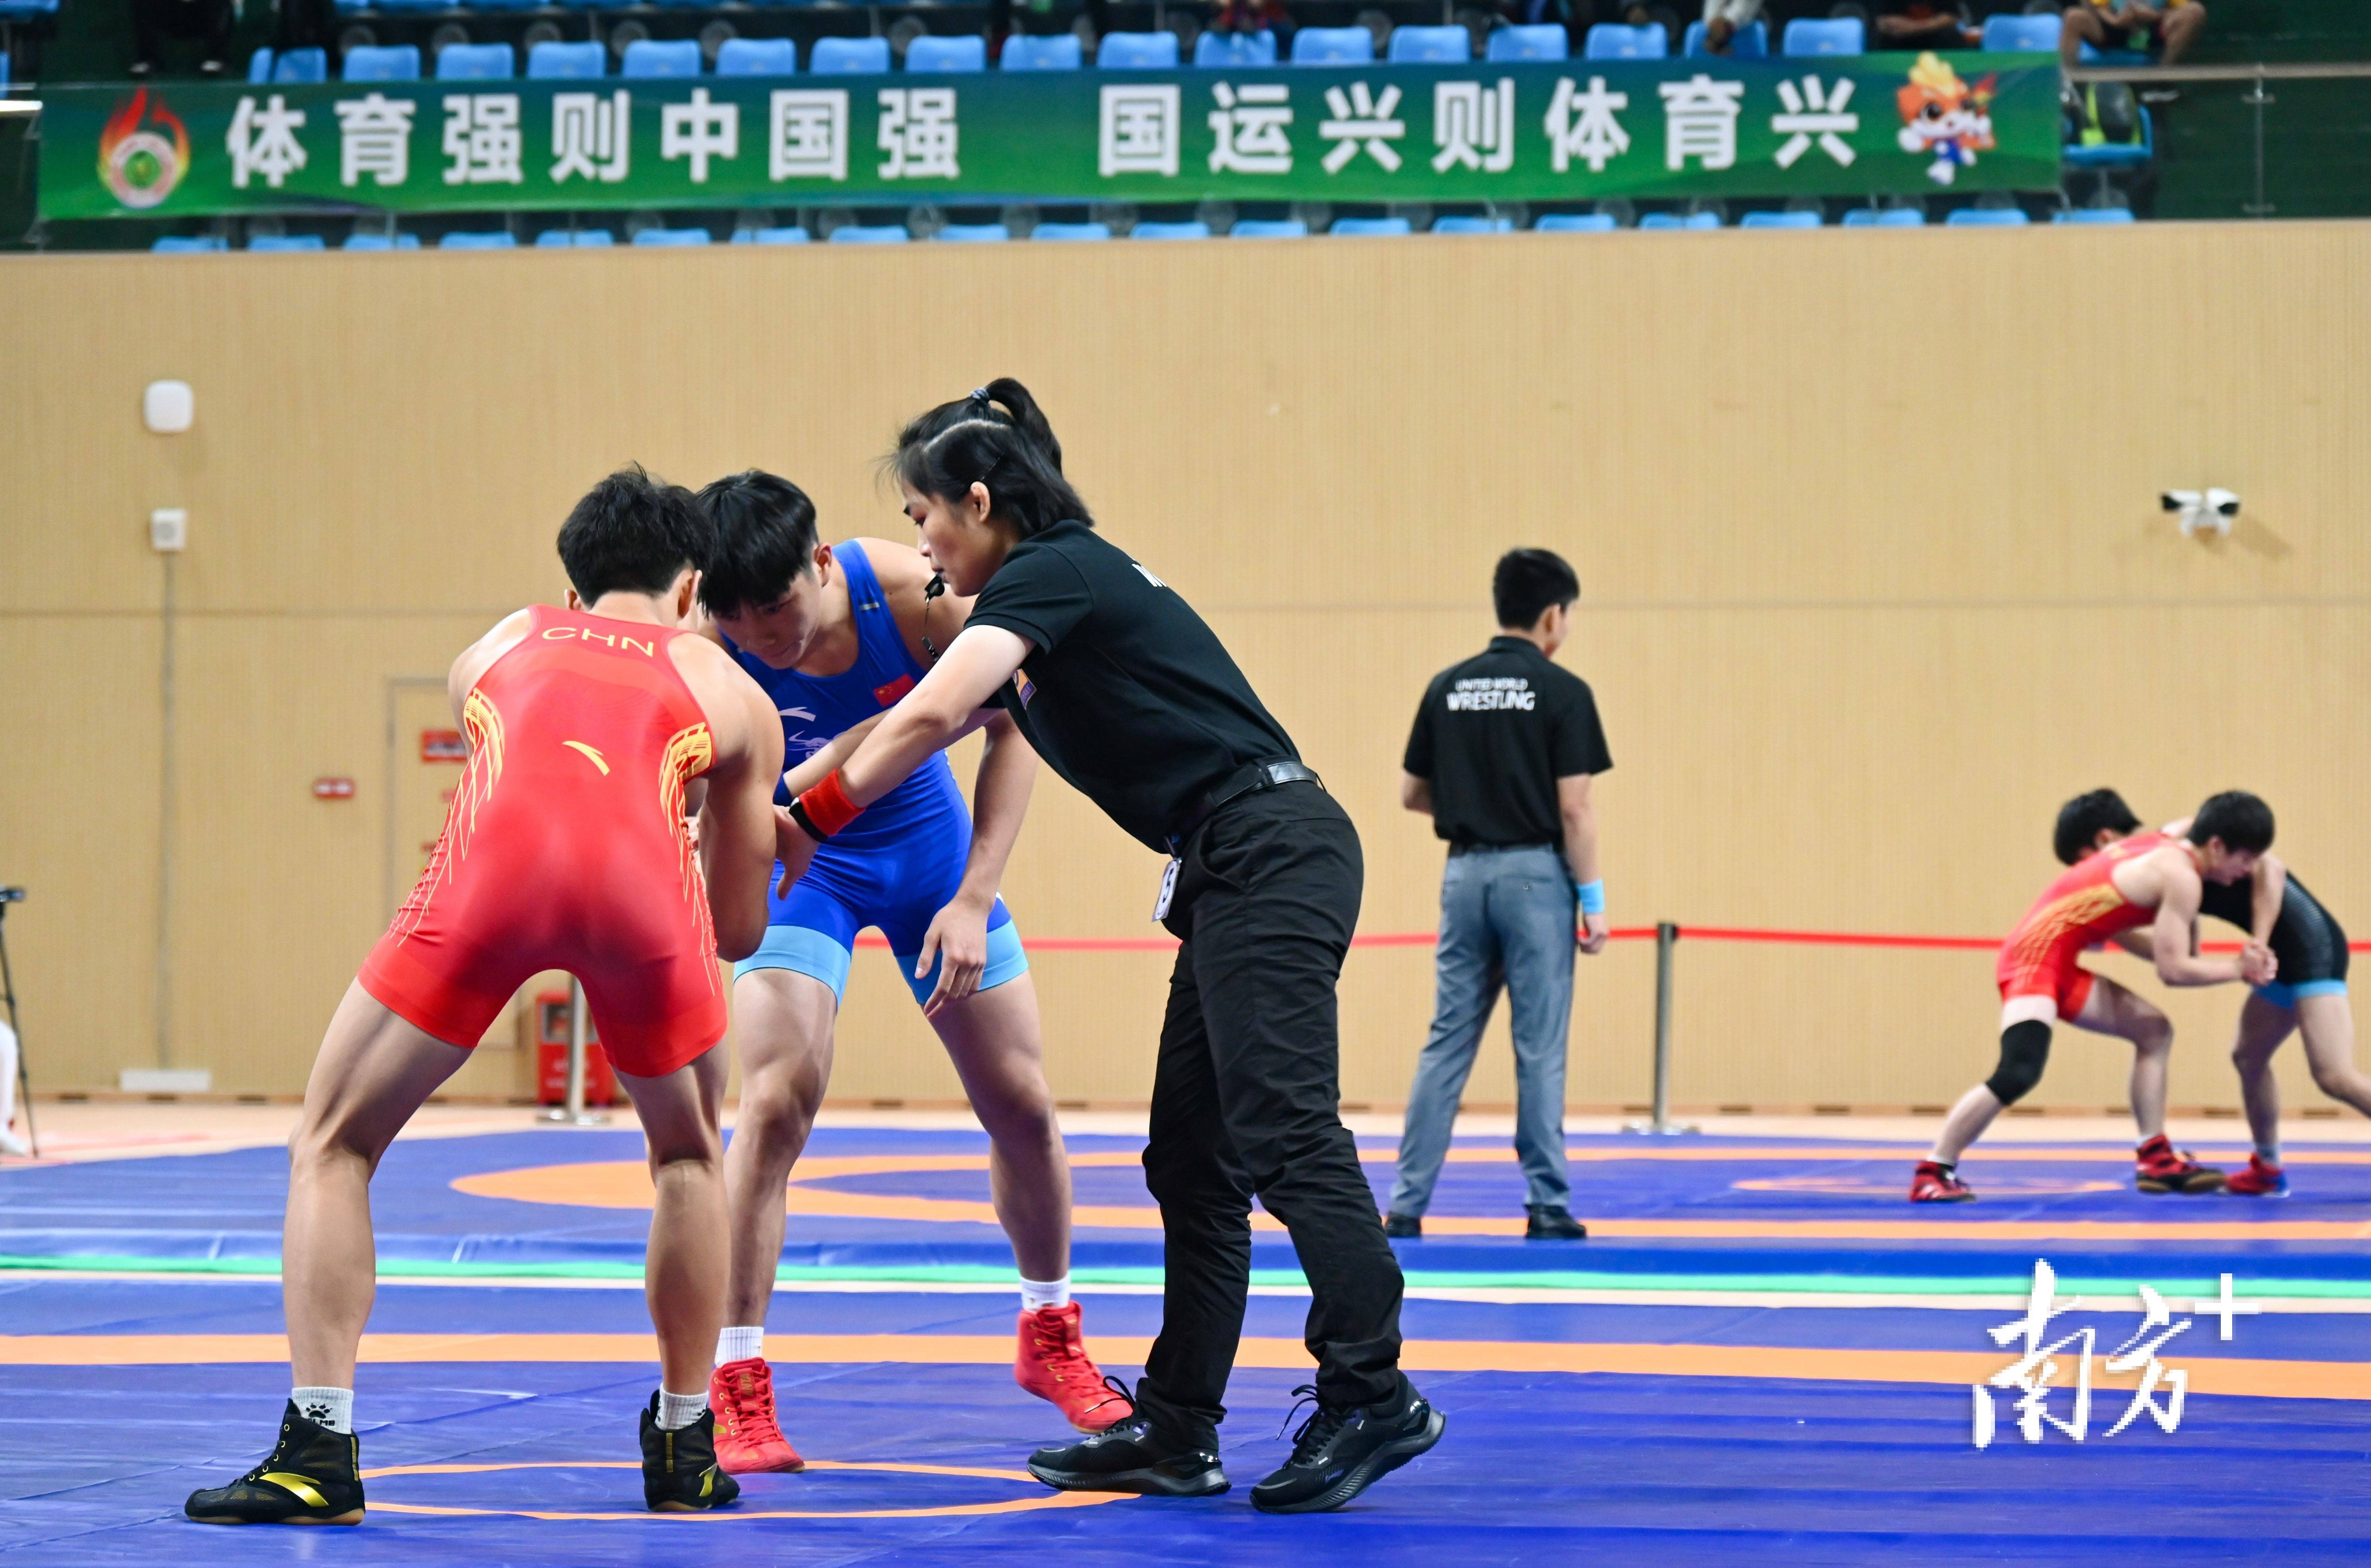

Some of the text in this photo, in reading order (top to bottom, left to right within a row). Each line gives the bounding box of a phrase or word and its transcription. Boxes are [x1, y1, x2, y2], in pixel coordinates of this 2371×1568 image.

[227, 74, 1859, 188] 体育强则中国强 国运兴则体育兴
[542, 627, 654, 658] CHN
[1455, 678, 1494, 691] UNITED
[1446, 690, 1536, 711] WRESTLING
